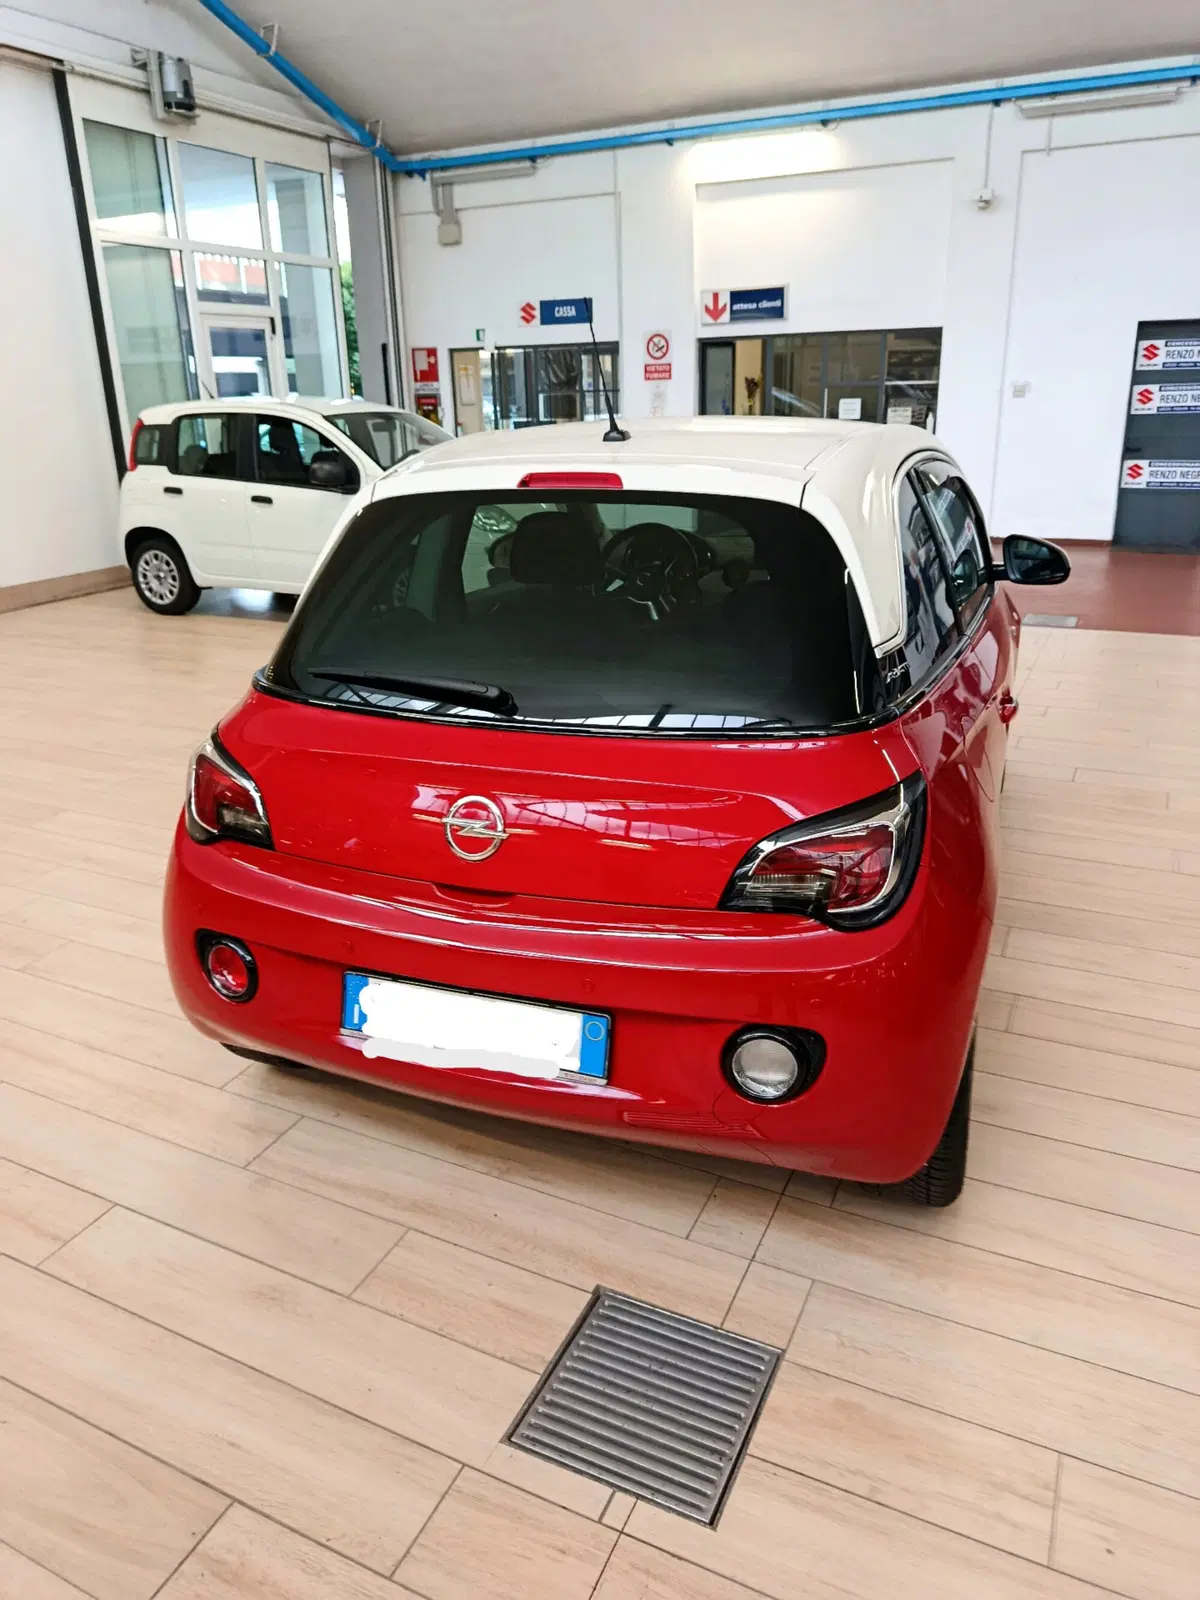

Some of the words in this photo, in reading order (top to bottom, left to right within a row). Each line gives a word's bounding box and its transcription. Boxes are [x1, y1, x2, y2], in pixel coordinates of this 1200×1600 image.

[758, 299, 782, 308] clienti
[554, 305, 577, 318] CASSA
[1165, 349, 1195, 360] RENZO
[1160, 394, 1189, 404] RENZO
[1149, 470, 1178, 480] RENZO
[353, 1003, 360, 1024] I
